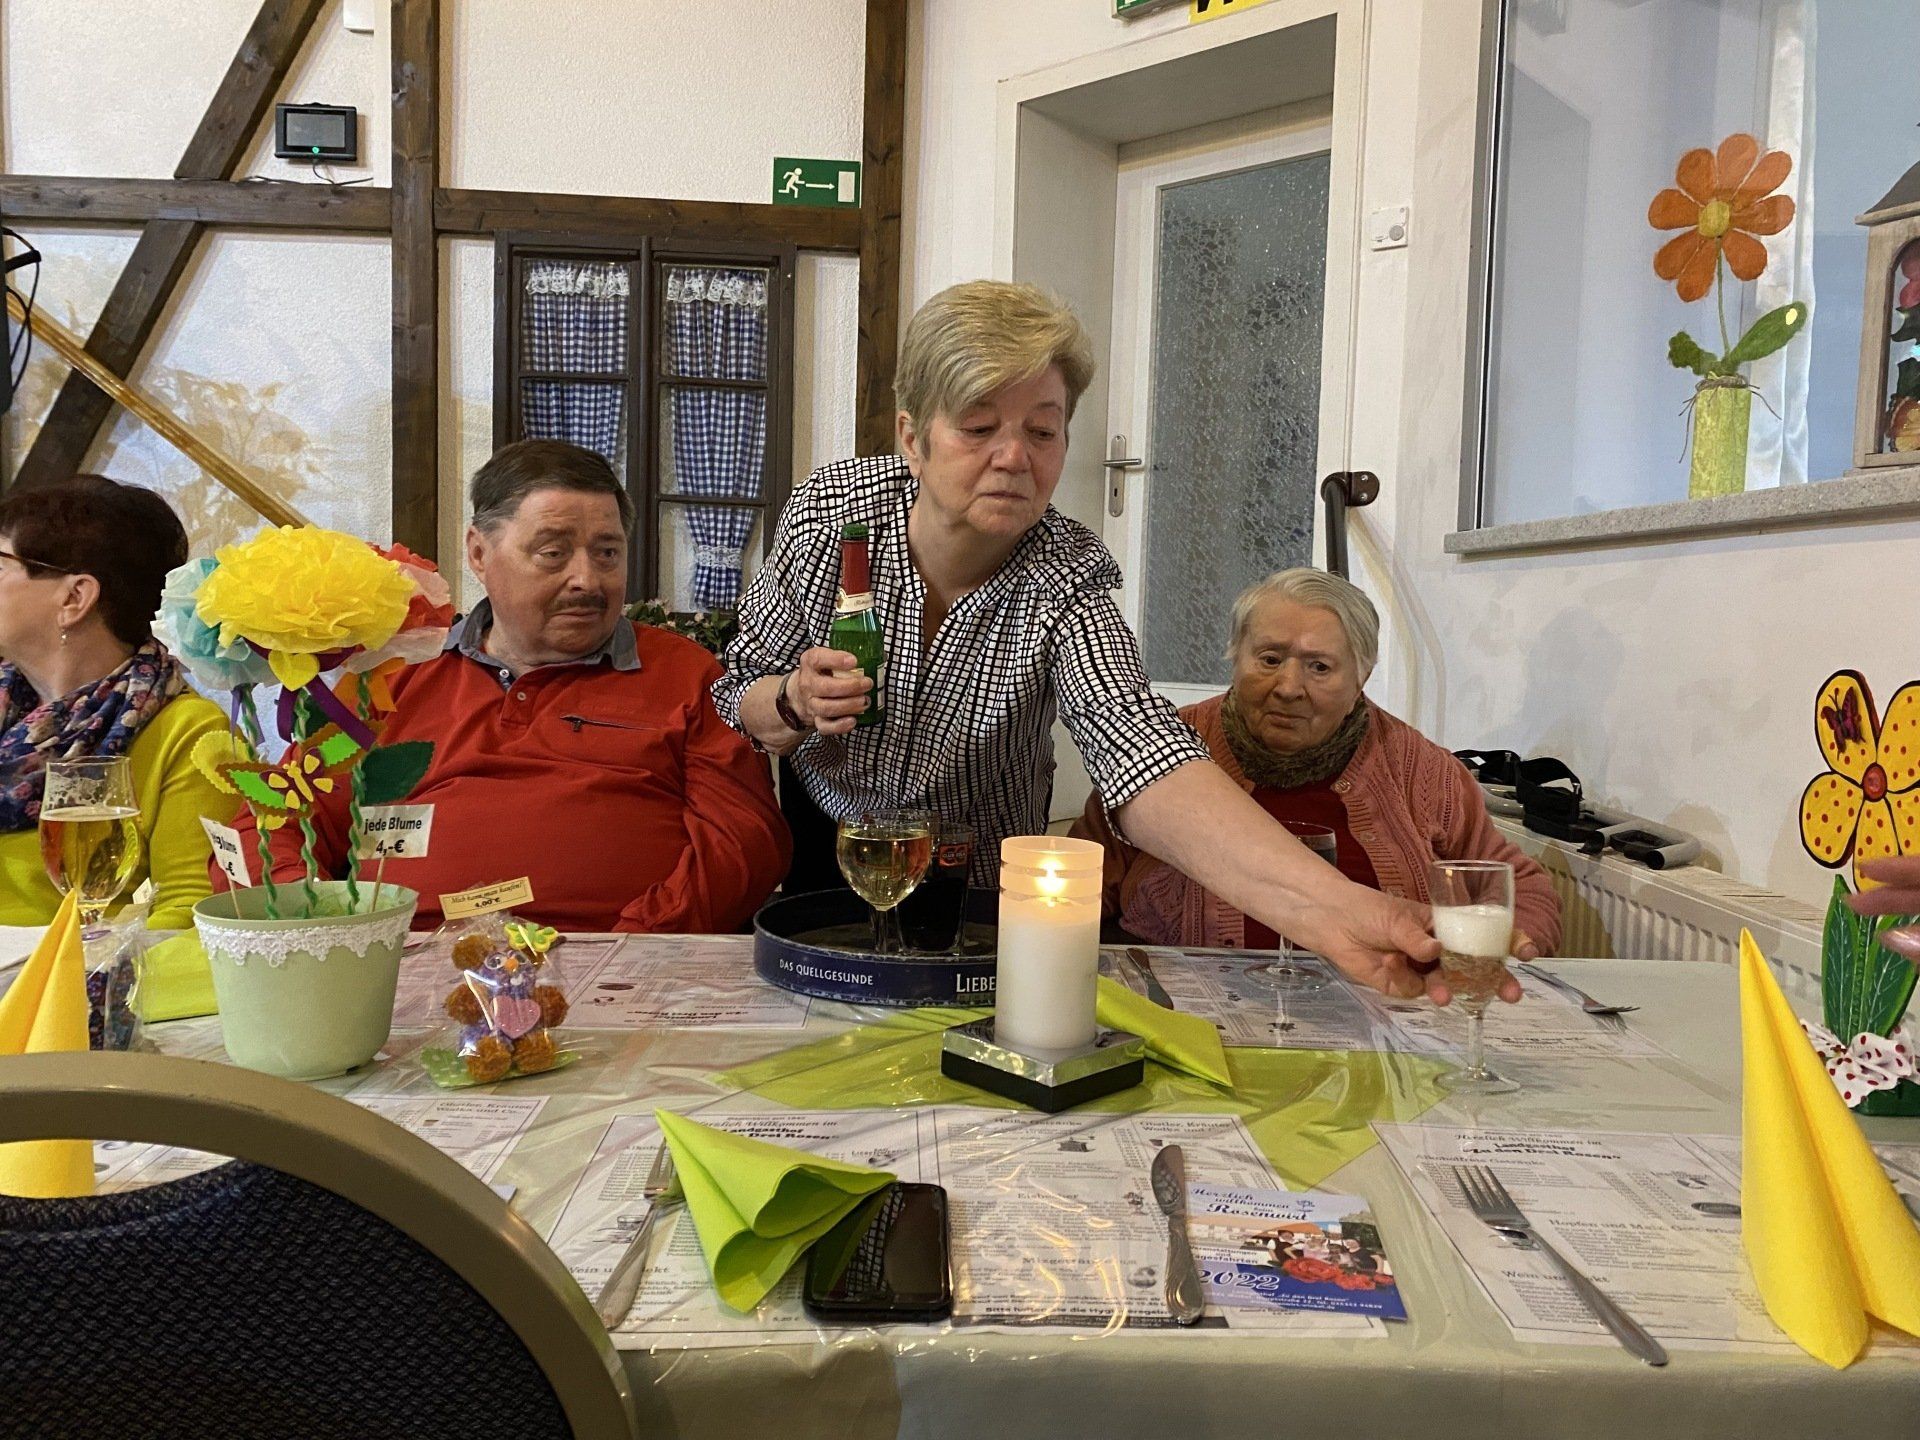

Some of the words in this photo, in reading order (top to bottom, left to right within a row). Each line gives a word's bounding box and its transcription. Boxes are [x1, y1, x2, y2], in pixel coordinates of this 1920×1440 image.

[364, 819, 387, 834] jede
[388, 817, 422, 830] Blume
[376, 839, 405, 855] 4,-€
[779, 958, 793, 972] DAS
[796, 964, 873, 985] QUELLGESUNDE
[956, 974, 996, 994] LIEBE
[1207, 1203, 1307, 1221] Rosenwirt
[1191, 1245, 1257, 1256] eranstaltungen
[1194, 1253, 1259, 1264] agesfahrten
[1200, 1269, 1280, 1291] 2022
